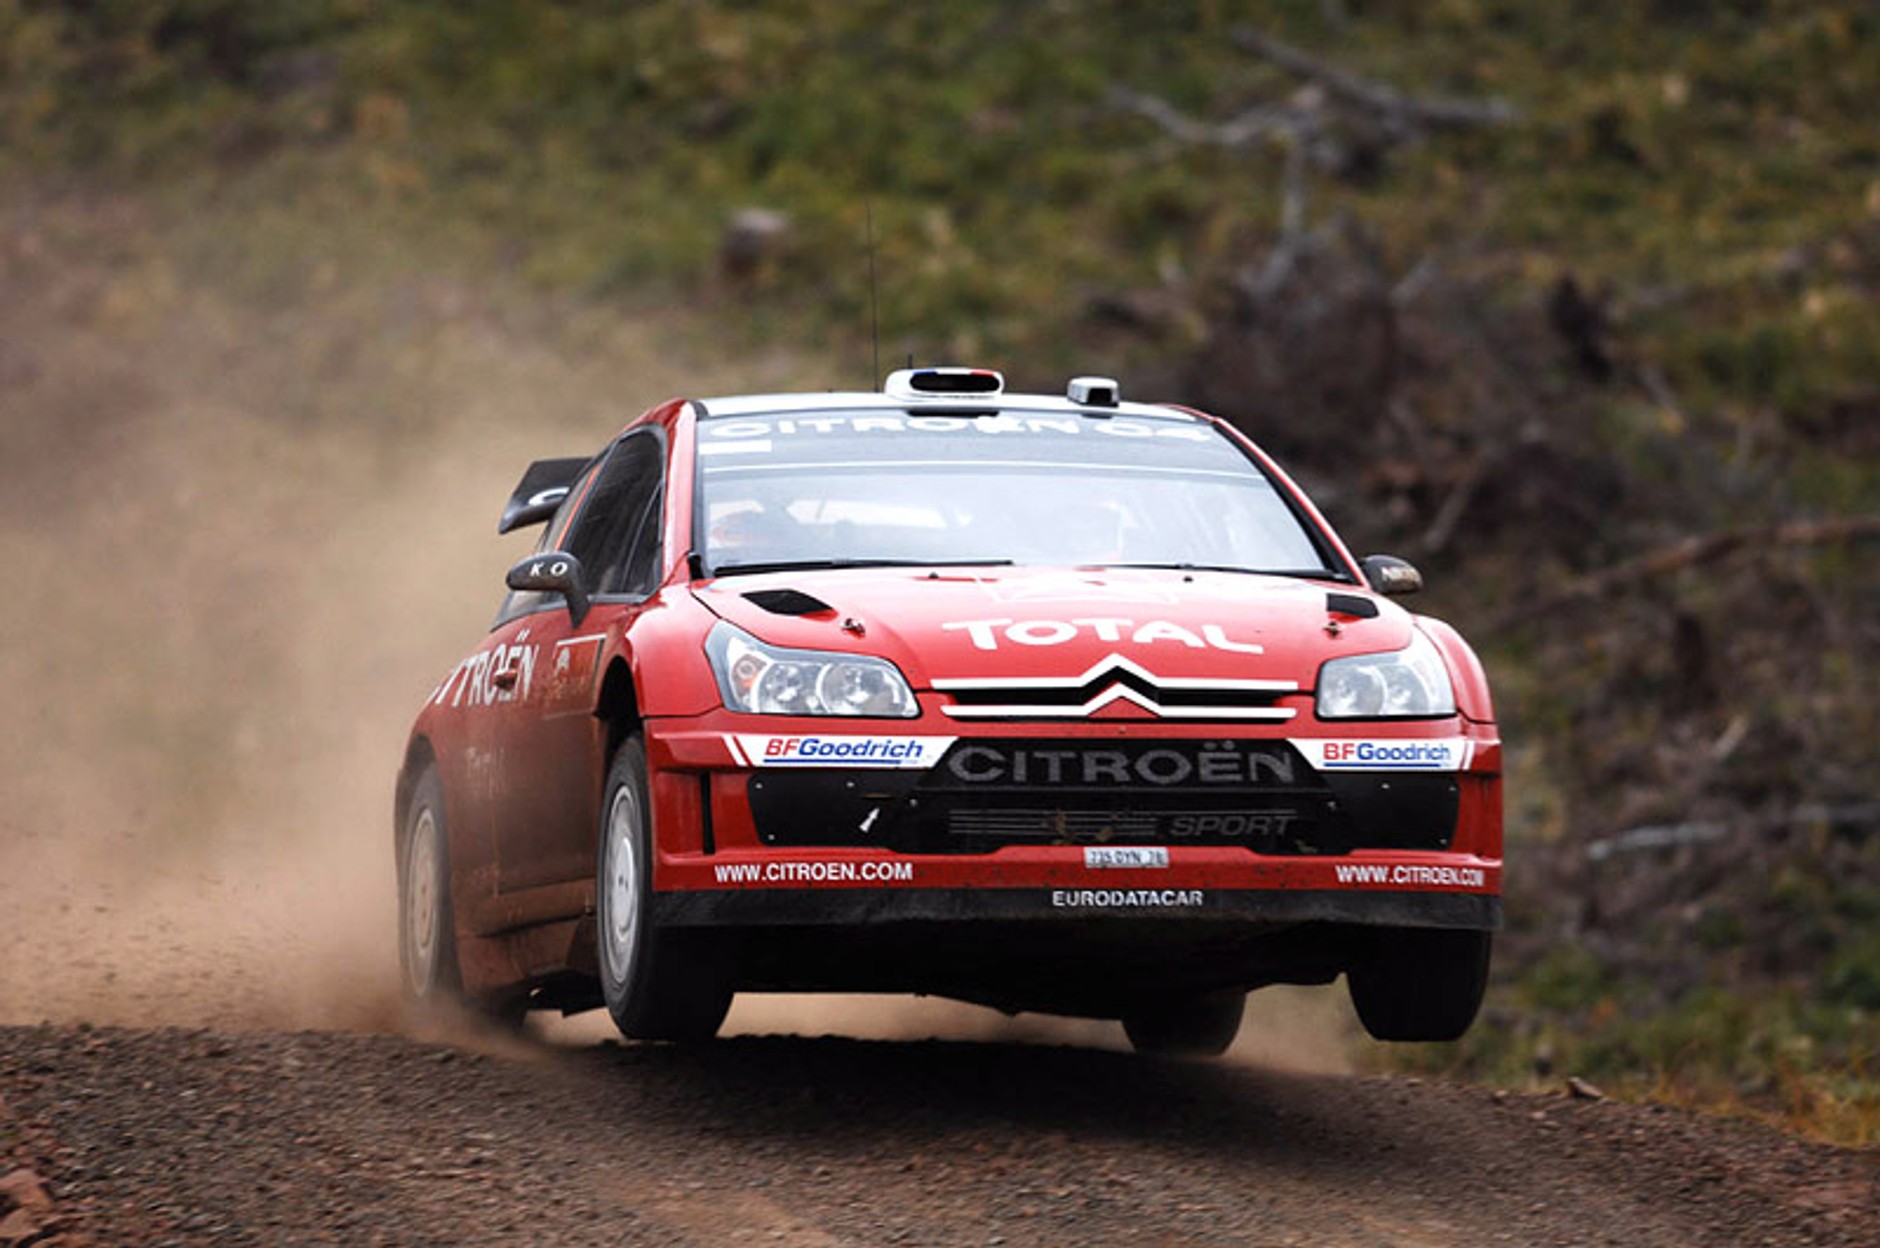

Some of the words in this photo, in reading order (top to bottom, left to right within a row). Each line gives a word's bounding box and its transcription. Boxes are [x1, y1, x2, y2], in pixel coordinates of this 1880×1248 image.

[941, 618, 1264, 654] TOTAL
[764, 738, 924, 758] BFGoodrich
[1323, 742, 1451, 761] BFGoodrich
[950, 740, 1294, 784] CITROËN
[1169, 815, 1298, 837] SPORT
[715, 862, 913, 882] WWW.CITROEN.COM
[1052, 889, 1203, 907] EURODATACAR
